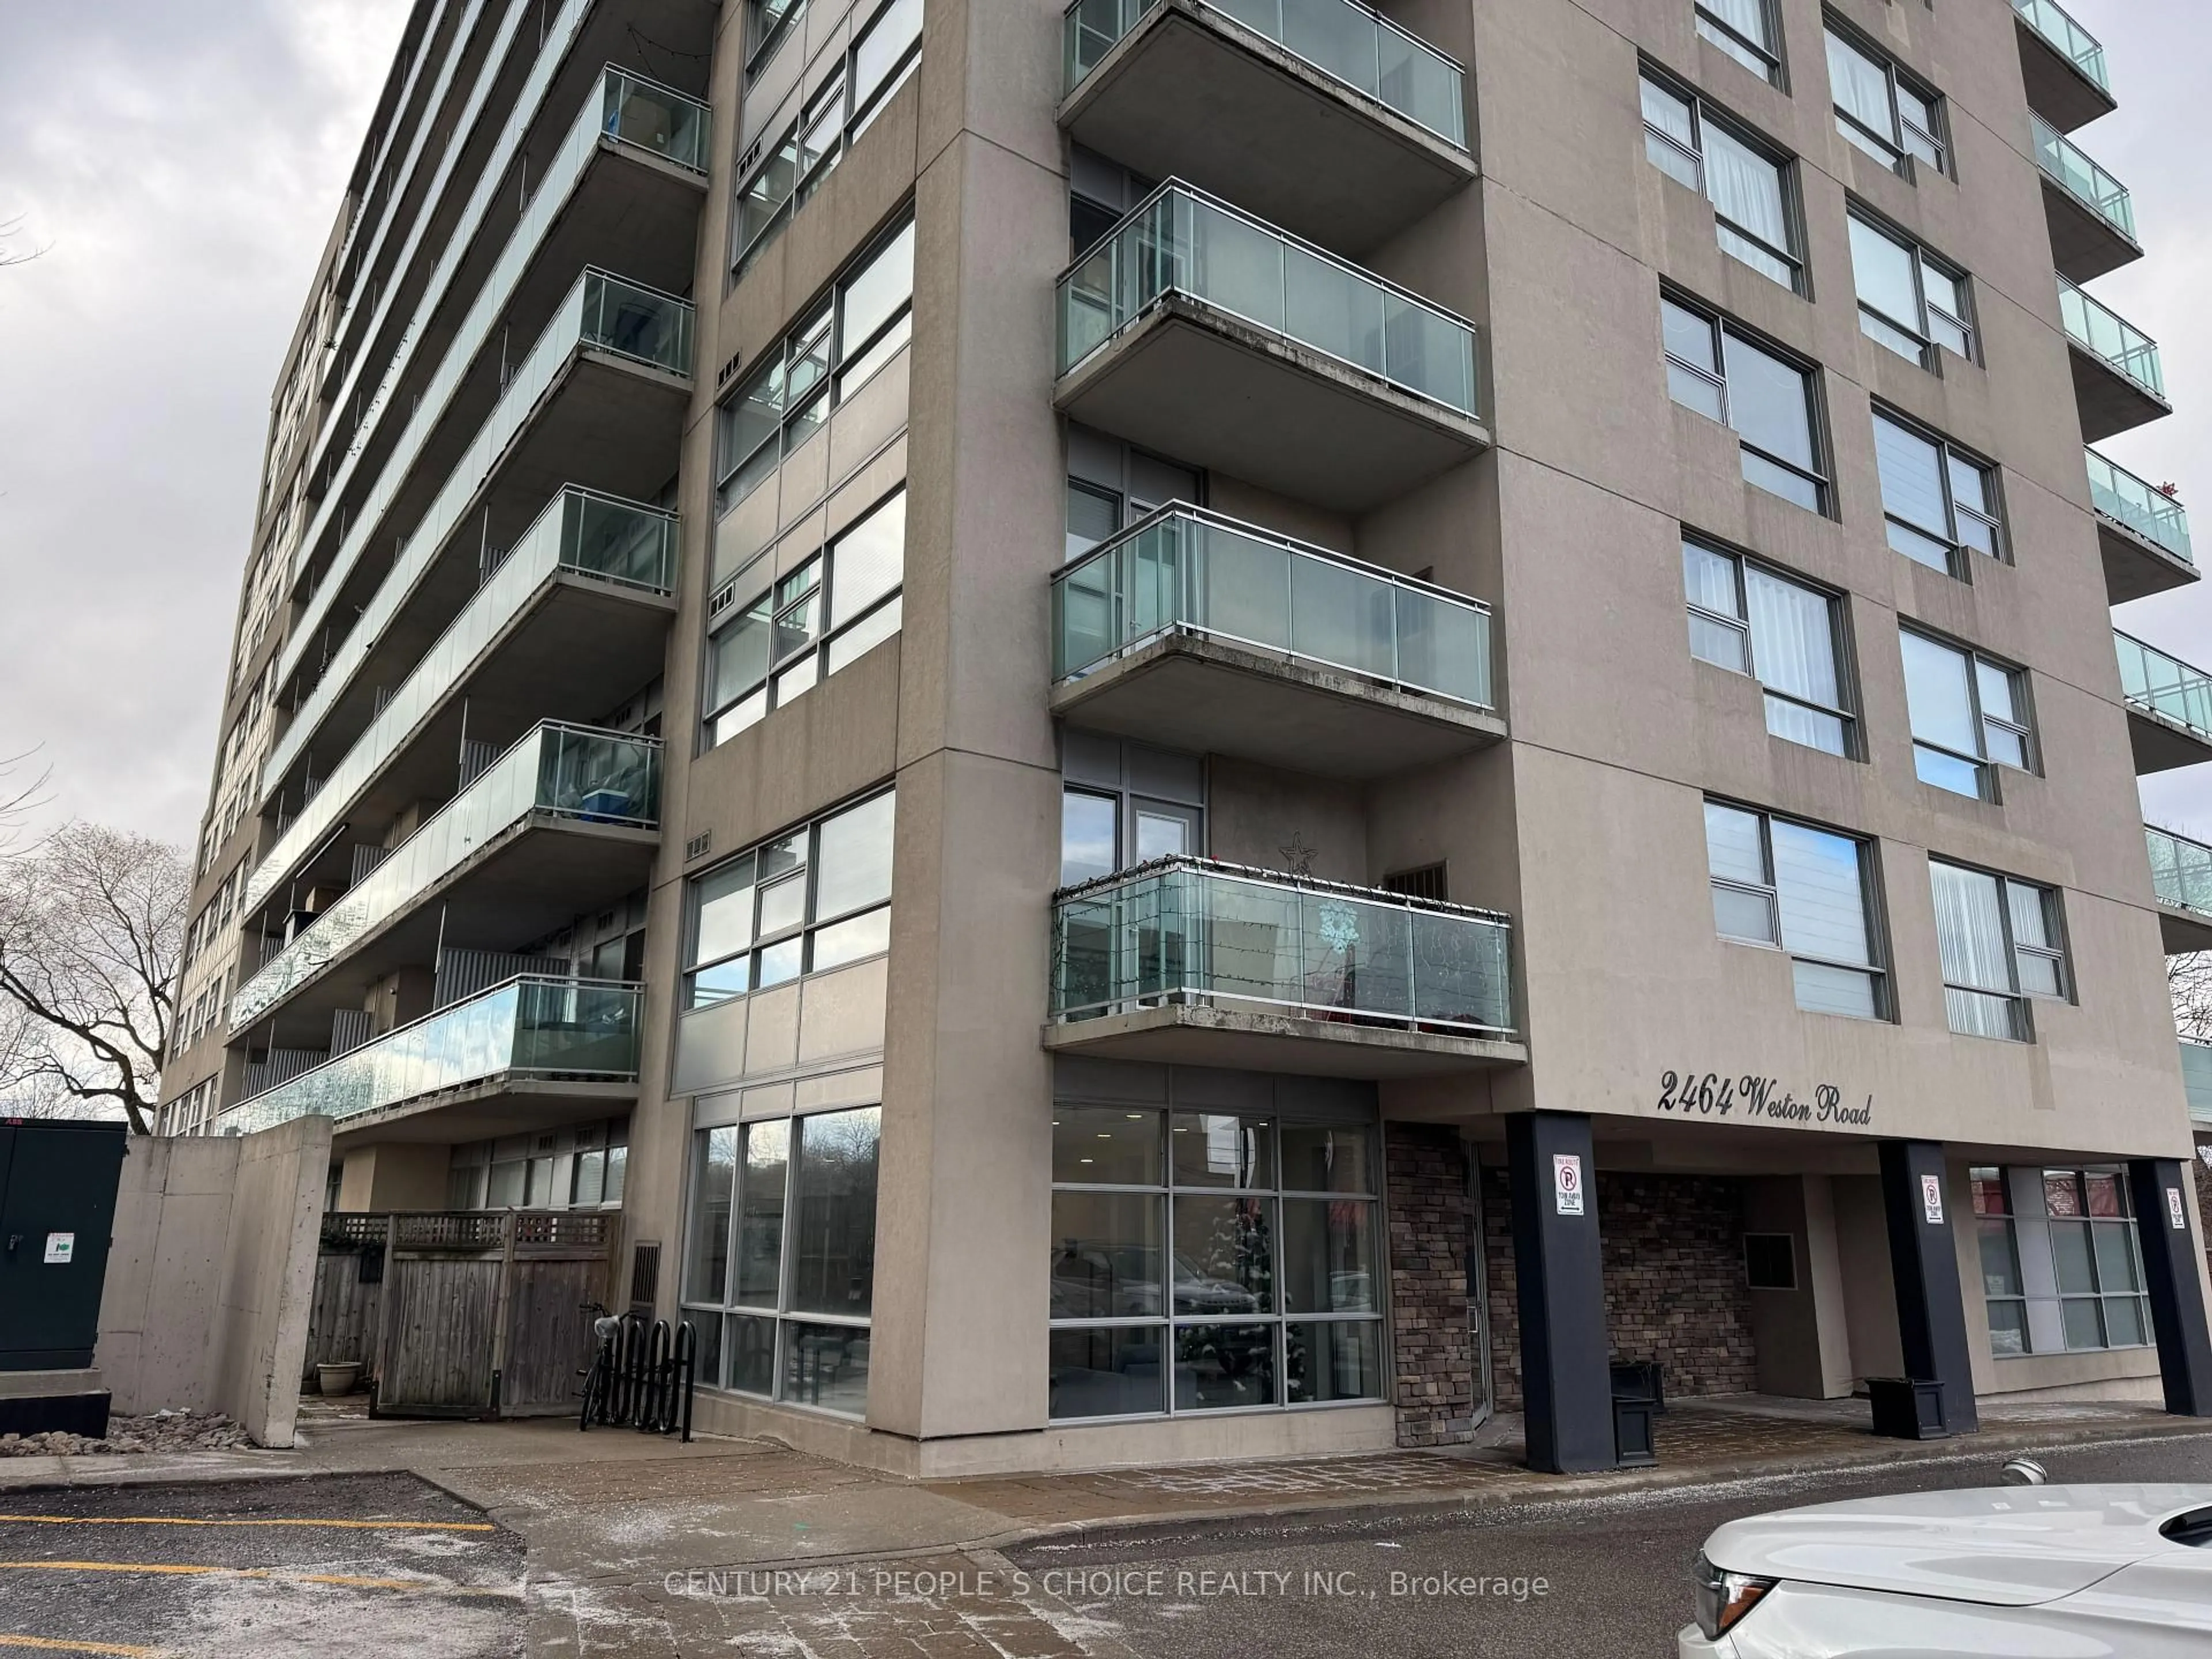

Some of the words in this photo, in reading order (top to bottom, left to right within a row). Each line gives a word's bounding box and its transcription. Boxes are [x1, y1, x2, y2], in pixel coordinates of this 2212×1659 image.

[1657, 1070, 1733, 1115] 2464
[1739, 1075, 1812, 1121] Weston
[1815, 1084, 1873, 1126] Road
